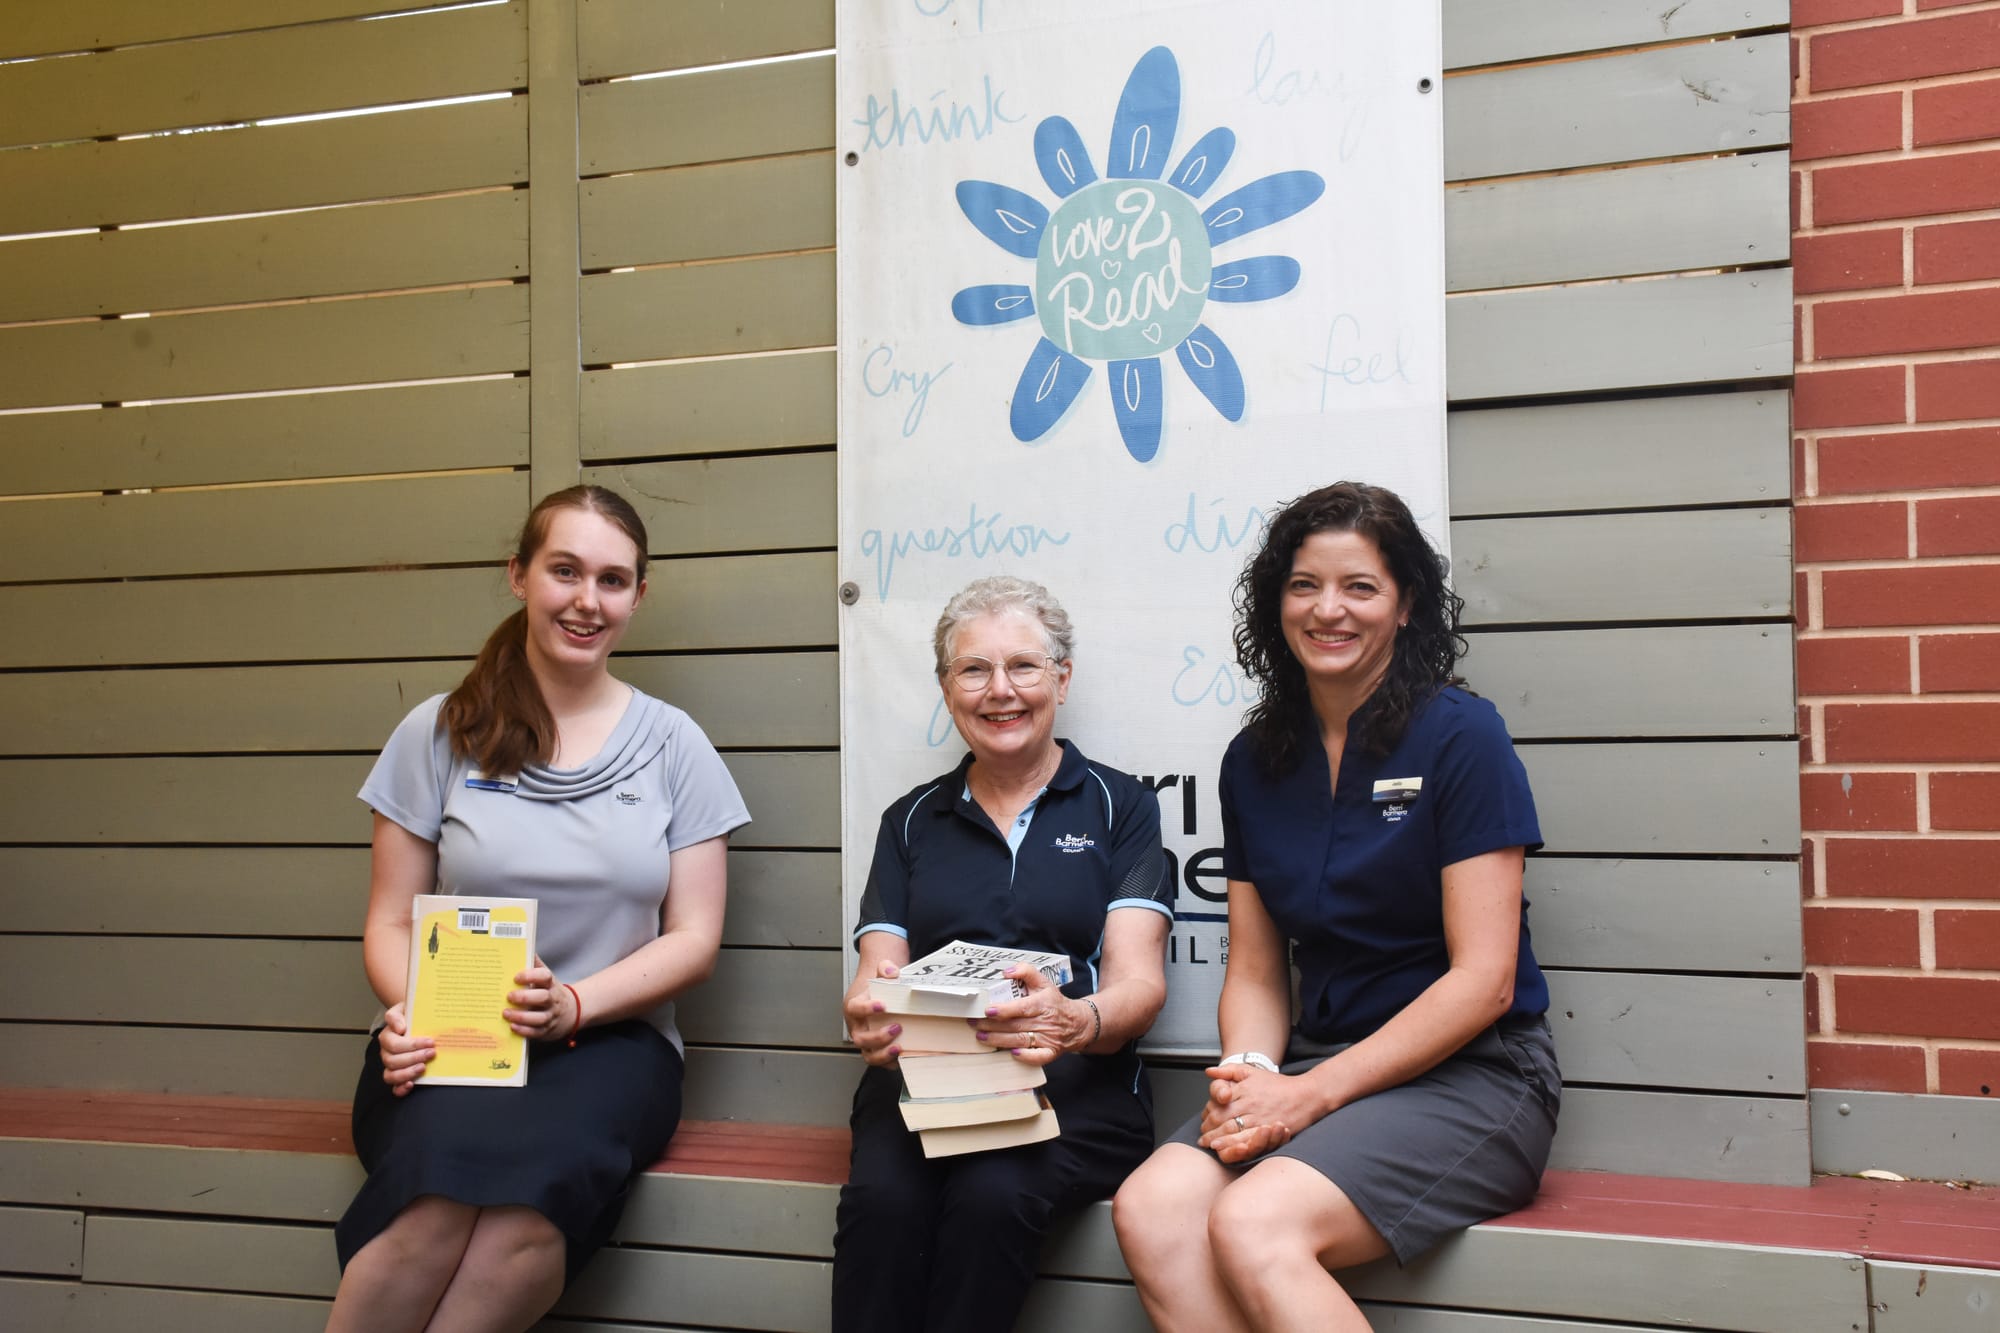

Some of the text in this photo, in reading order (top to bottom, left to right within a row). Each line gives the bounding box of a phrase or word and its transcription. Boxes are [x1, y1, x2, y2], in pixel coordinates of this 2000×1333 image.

[852, 73, 1027, 152] think
[1115, 187, 1171, 260] 2
[1048, 237, 1209, 353] Read
[863, 346, 954, 438] Cry
[1309, 312, 1416, 413] feel
[861, 502, 1071, 604] question
[913, 964, 1003, 980] THS
[946, 947, 1051, 963] HPPINESS
